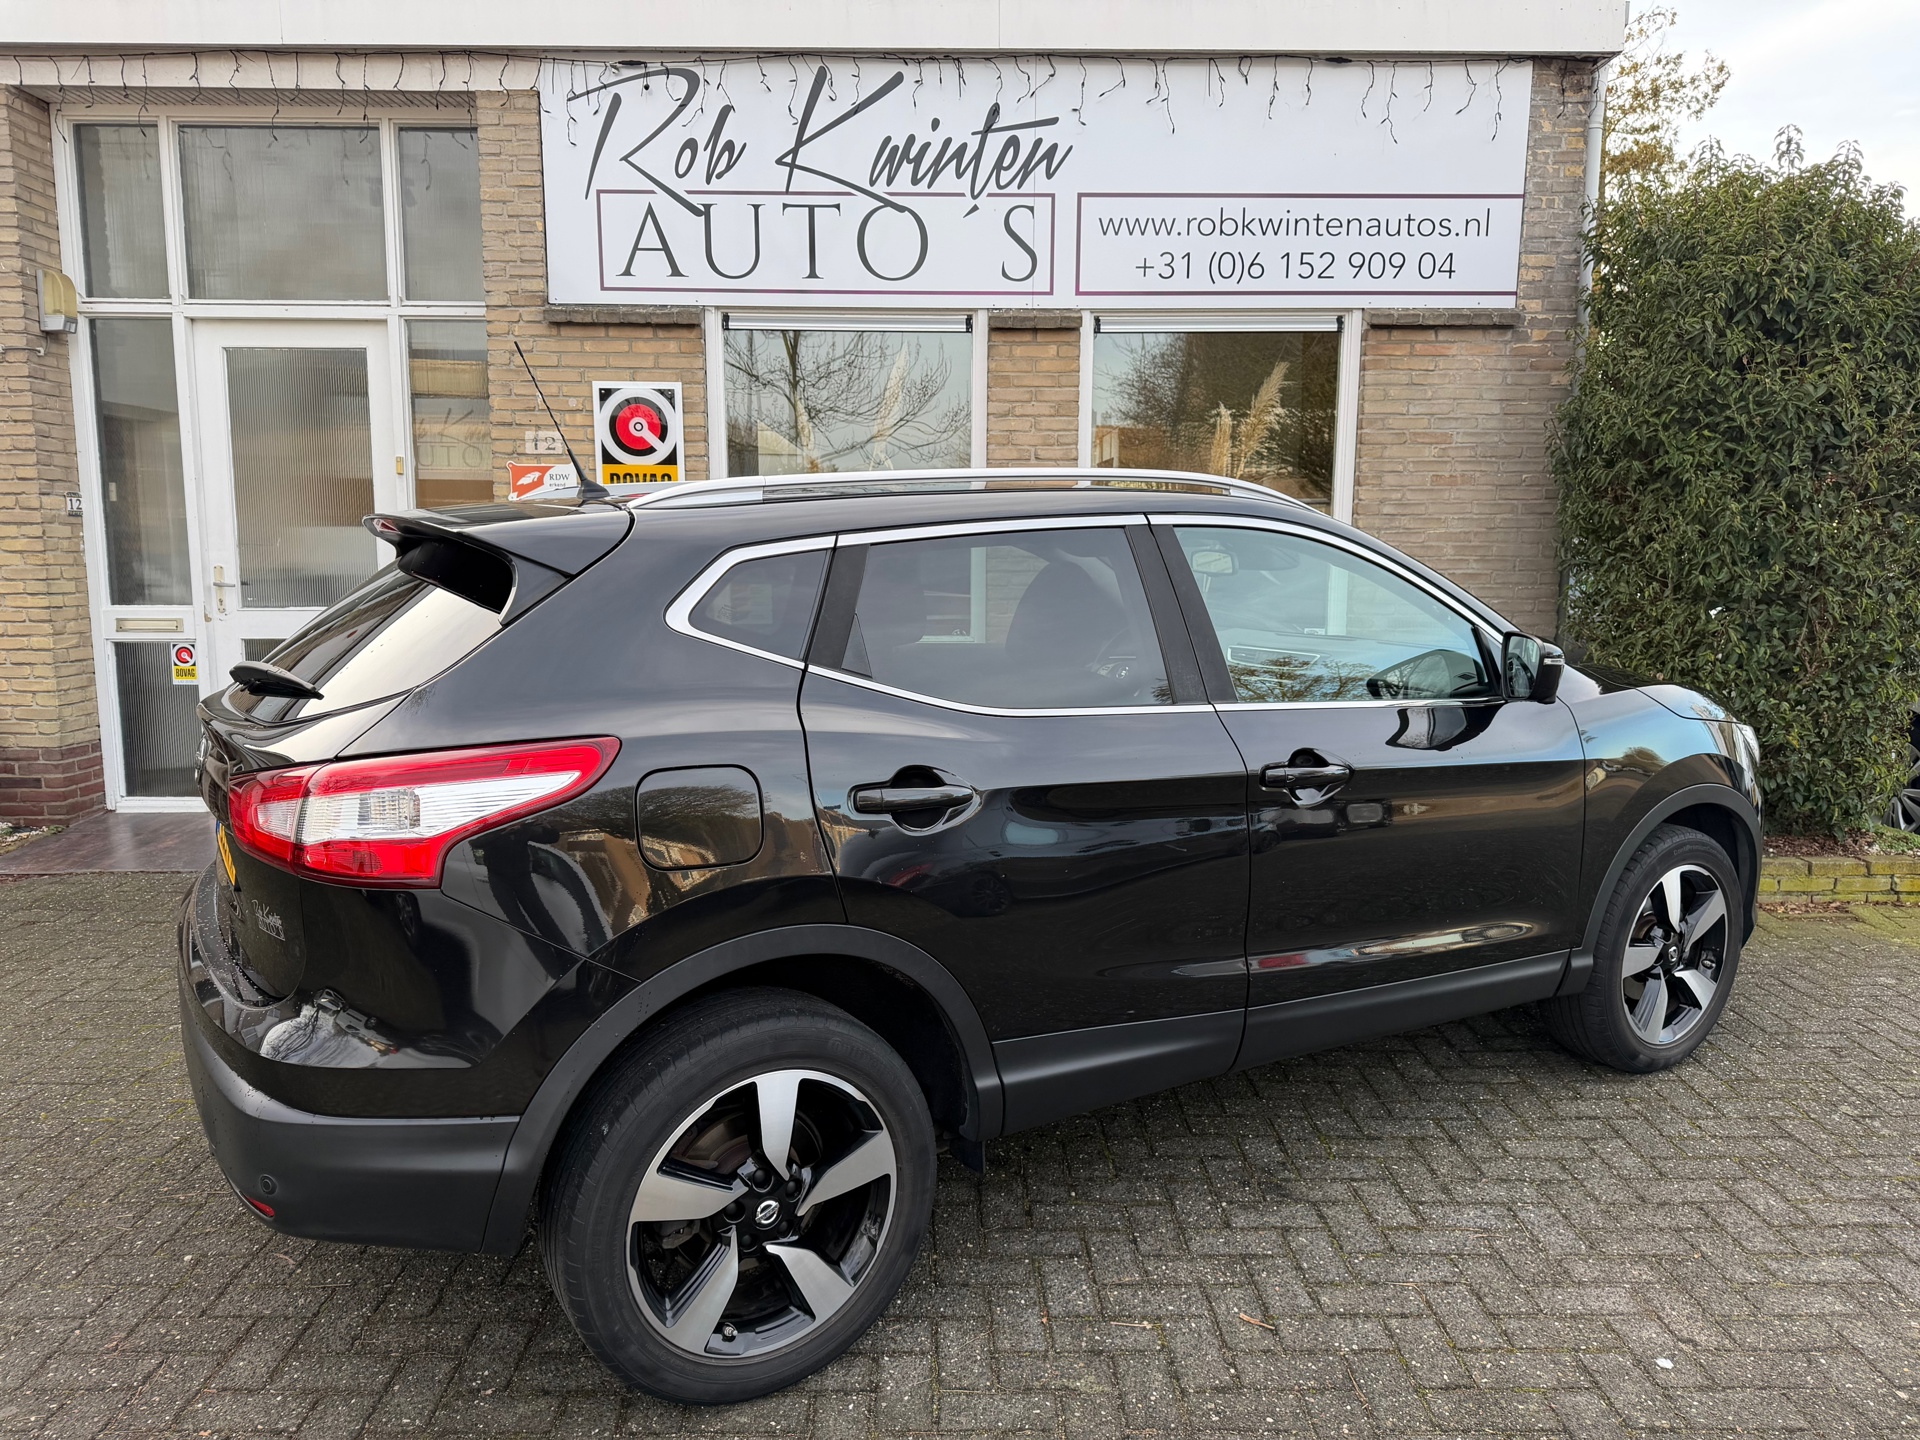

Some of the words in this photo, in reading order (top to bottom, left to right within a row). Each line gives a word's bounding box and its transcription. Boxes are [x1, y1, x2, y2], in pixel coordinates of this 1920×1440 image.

[567, 68, 747, 217] Rob
[775, 66, 1073, 214] Kwinten
[1098, 207, 1490, 237] www.robkwintenautos.nl
[1135, 251, 1192, 279] +31
[1208, 250, 1265, 284] (0)6
[1280, 252, 1335, 280] 152
[1348, 252, 1406, 280] 909
[1418, 252, 1456, 280] 04
[69, 498, 83, 510] 12
[175, 668, 196, 678] BOVAG
